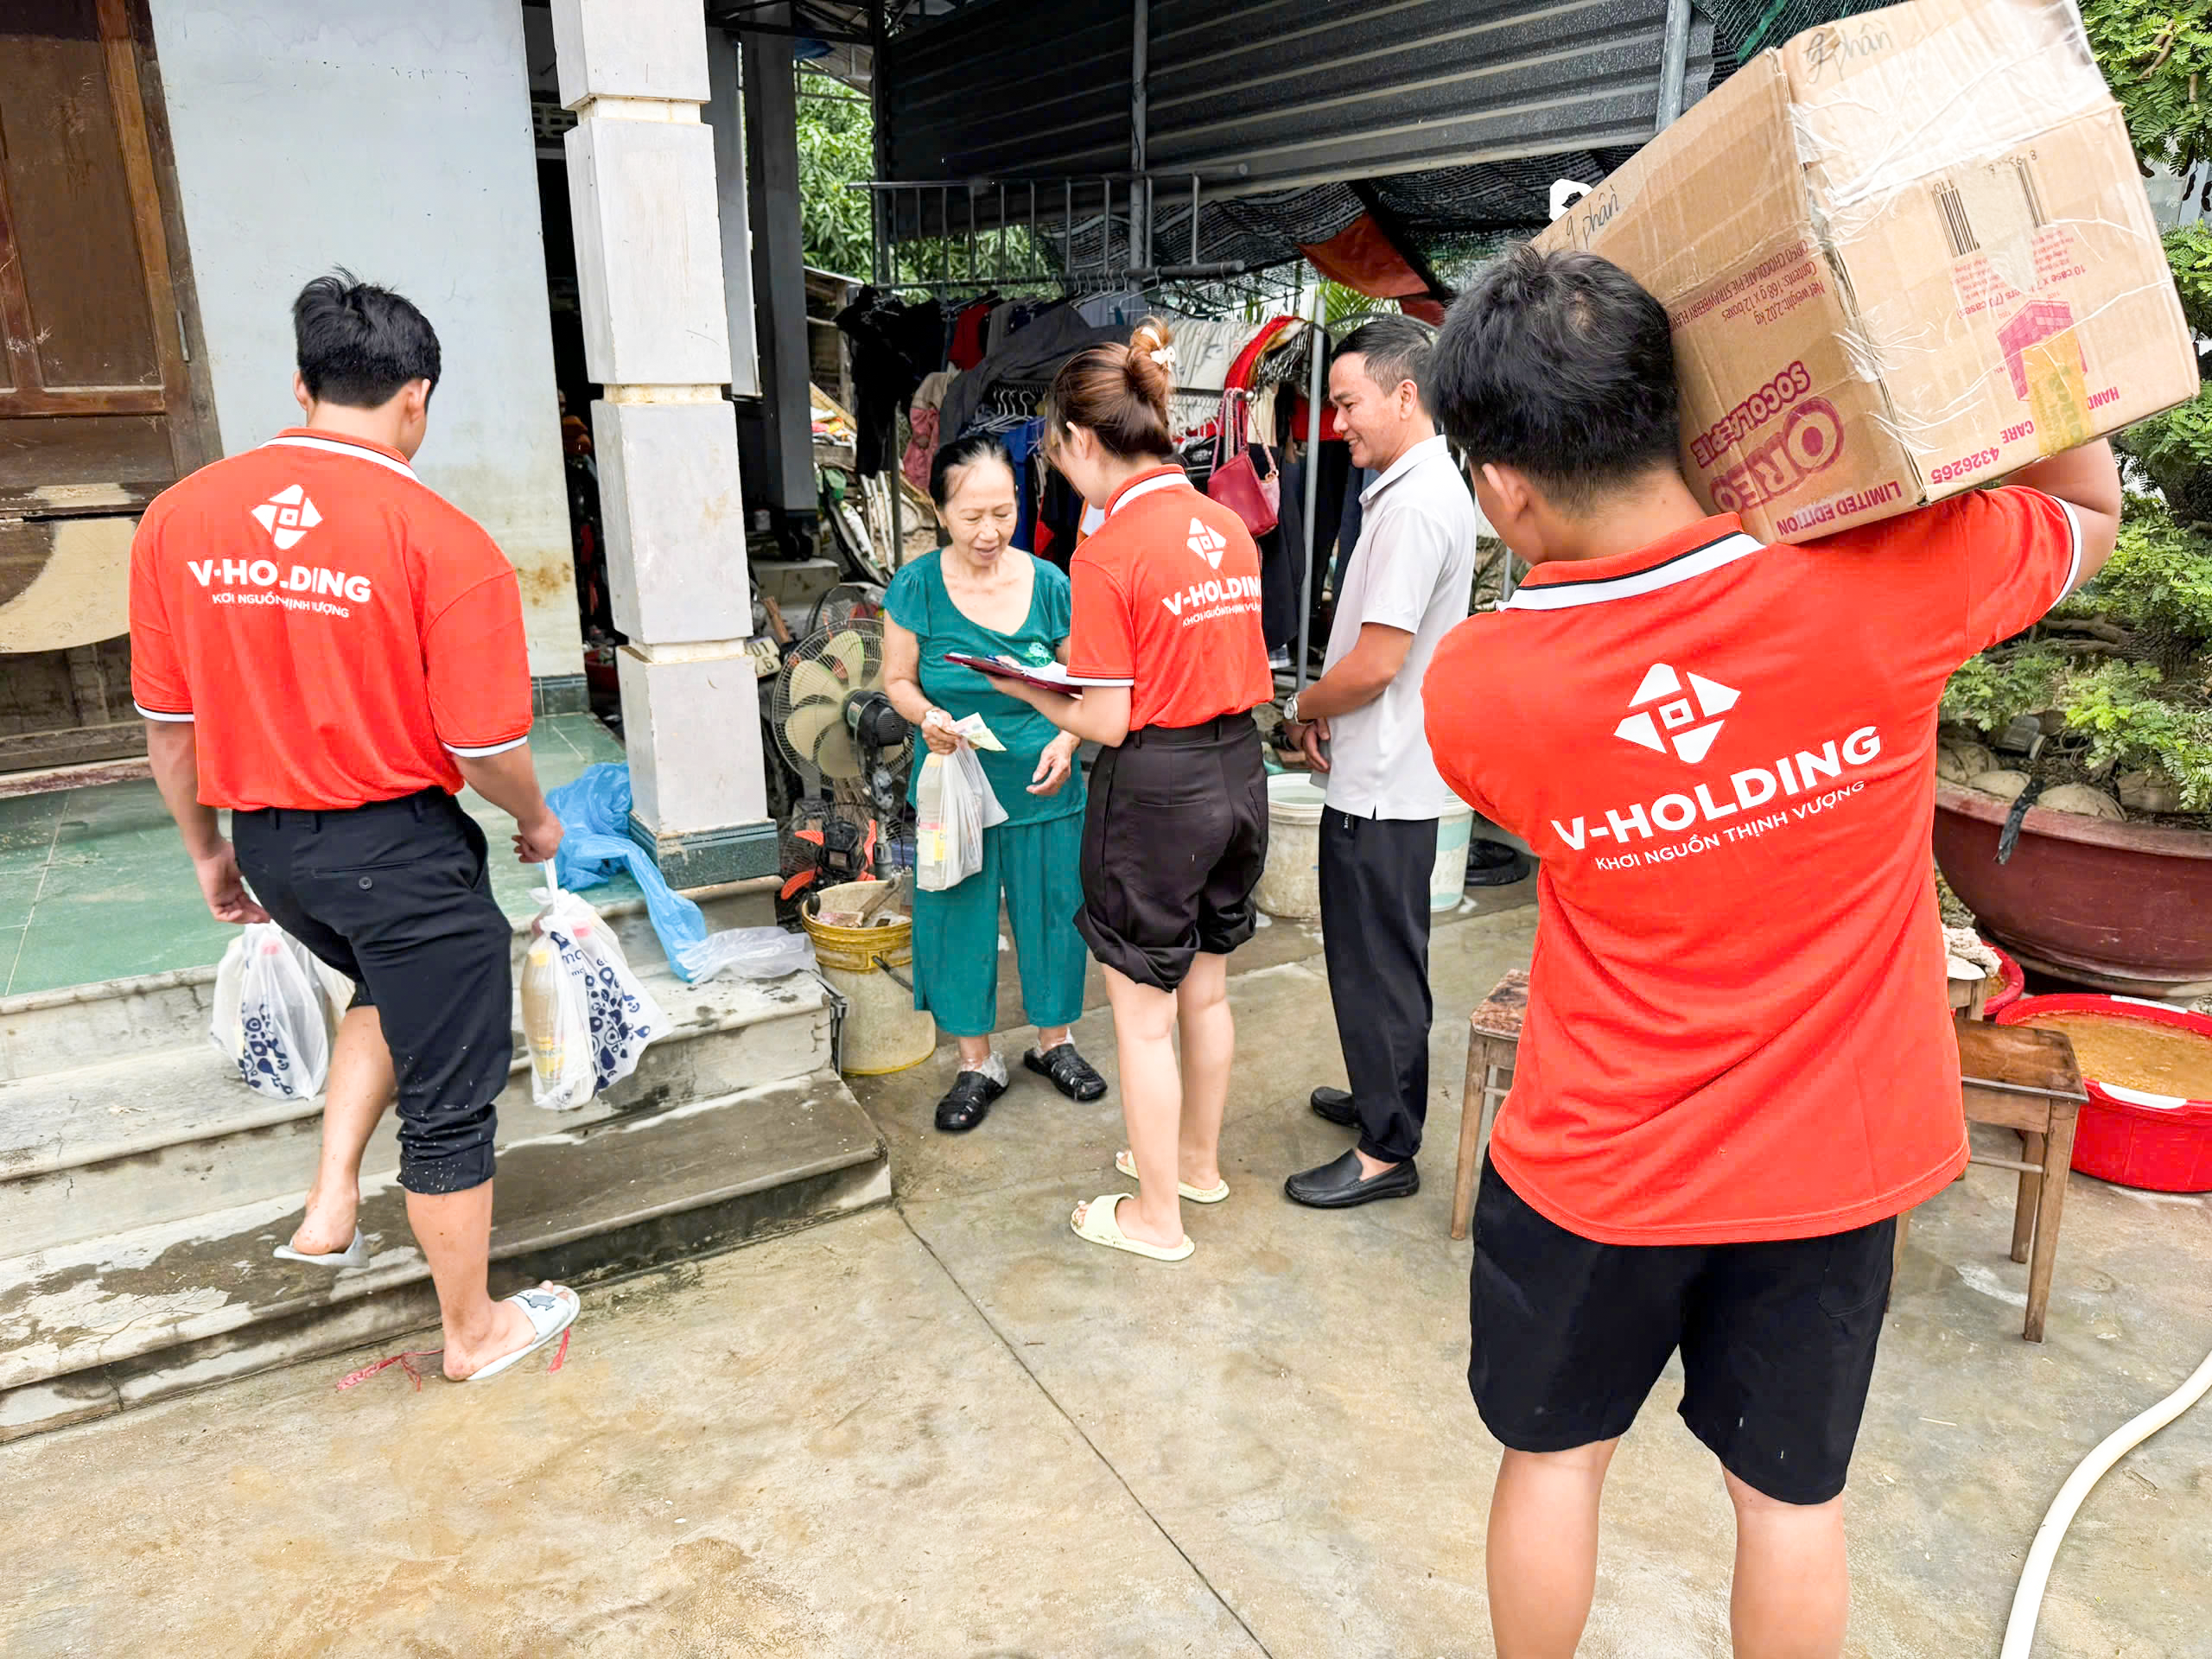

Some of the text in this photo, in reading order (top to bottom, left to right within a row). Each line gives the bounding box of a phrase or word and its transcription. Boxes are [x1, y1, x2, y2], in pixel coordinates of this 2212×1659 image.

[1582, 184, 1618, 250] phần
[1732, 276, 1748, 296] PIE
[1746, 252, 1786, 289] CHOCOLATE
[1783, 261, 1817, 288] Contents:
[2051, 268, 2073, 283] case
[1688, 283, 1734, 320] STRAWBERRY
[1743, 296, 1756, 314] 12
[1770, 280, 1784, 299] 168
[1783, 288, 1811, 311] weight:
[1809, 280, 1826, 299] Net
[1721, 302, 1745, 322] boxes
[1753, 310, 1769, 326] kg
[1999, 386, 2120, 445] HAND CARE
[1709, 396, 1845, 514] OREO
[1930, 446, 2000, 485] 4326265
[1776, 480, 1903, 536] LIMITED EDITION
[1161, 575, 1262, 616] V-HOLDIN
[1550, 726, 1882, 851] V-HOLDING
[1595, 780, 1866, 871] KHƠI NGUỒN THỊNH VƯỢNG
